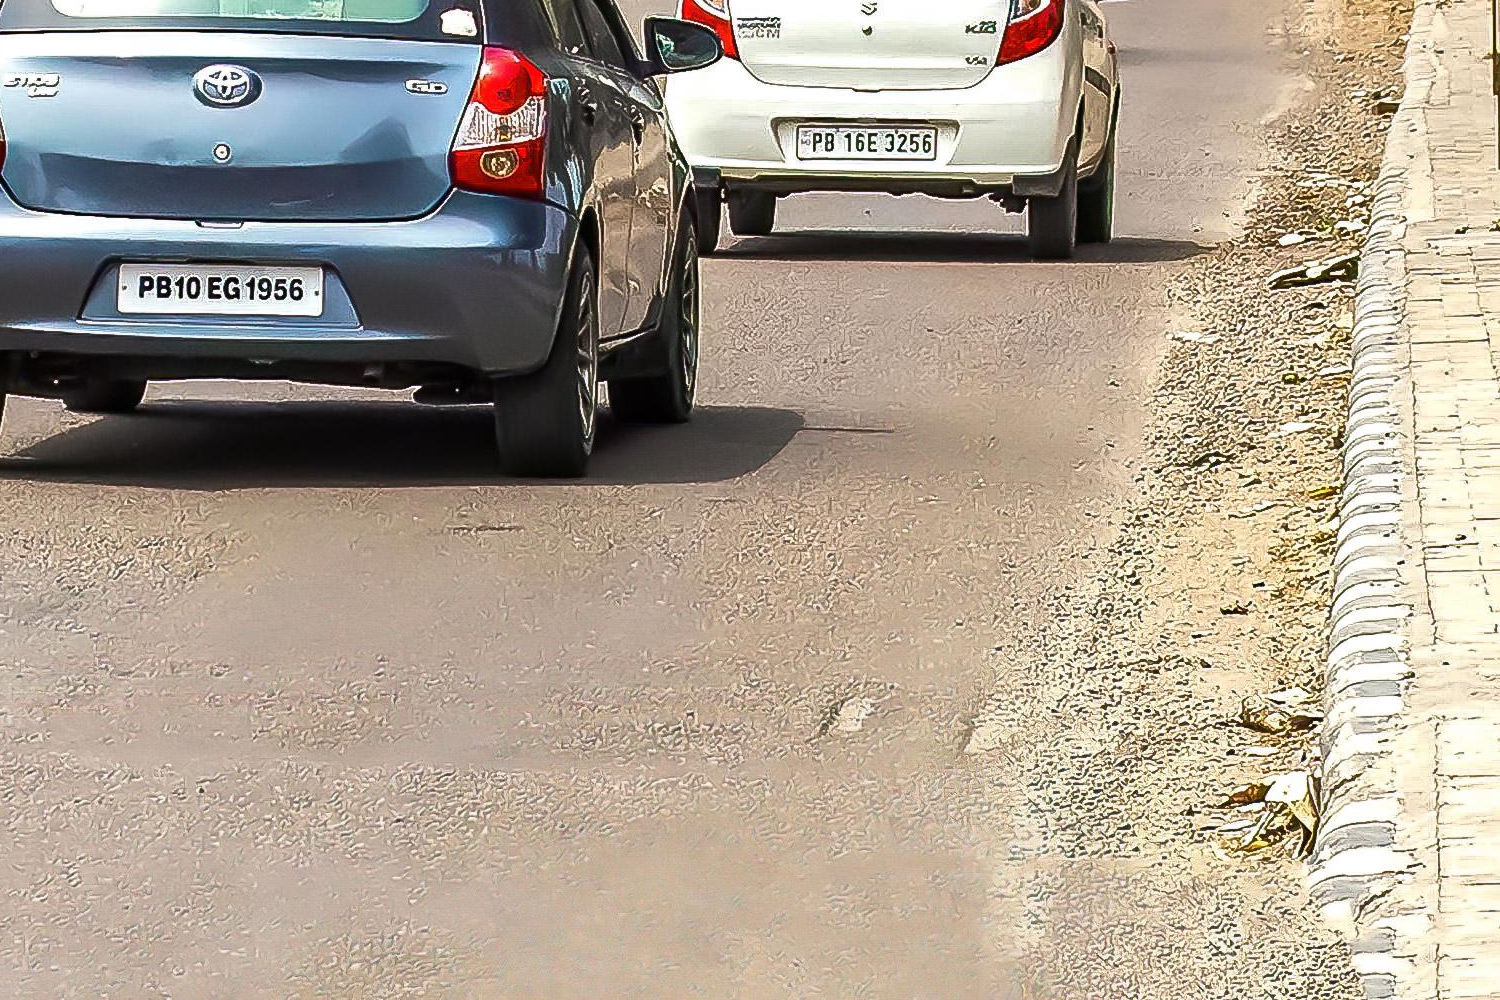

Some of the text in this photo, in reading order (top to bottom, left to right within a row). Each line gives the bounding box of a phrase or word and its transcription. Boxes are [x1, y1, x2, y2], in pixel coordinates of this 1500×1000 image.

[812, 132, 932, 153] PB 16E 3256
[138, 276, 304, 301] PB10 EG 1956
